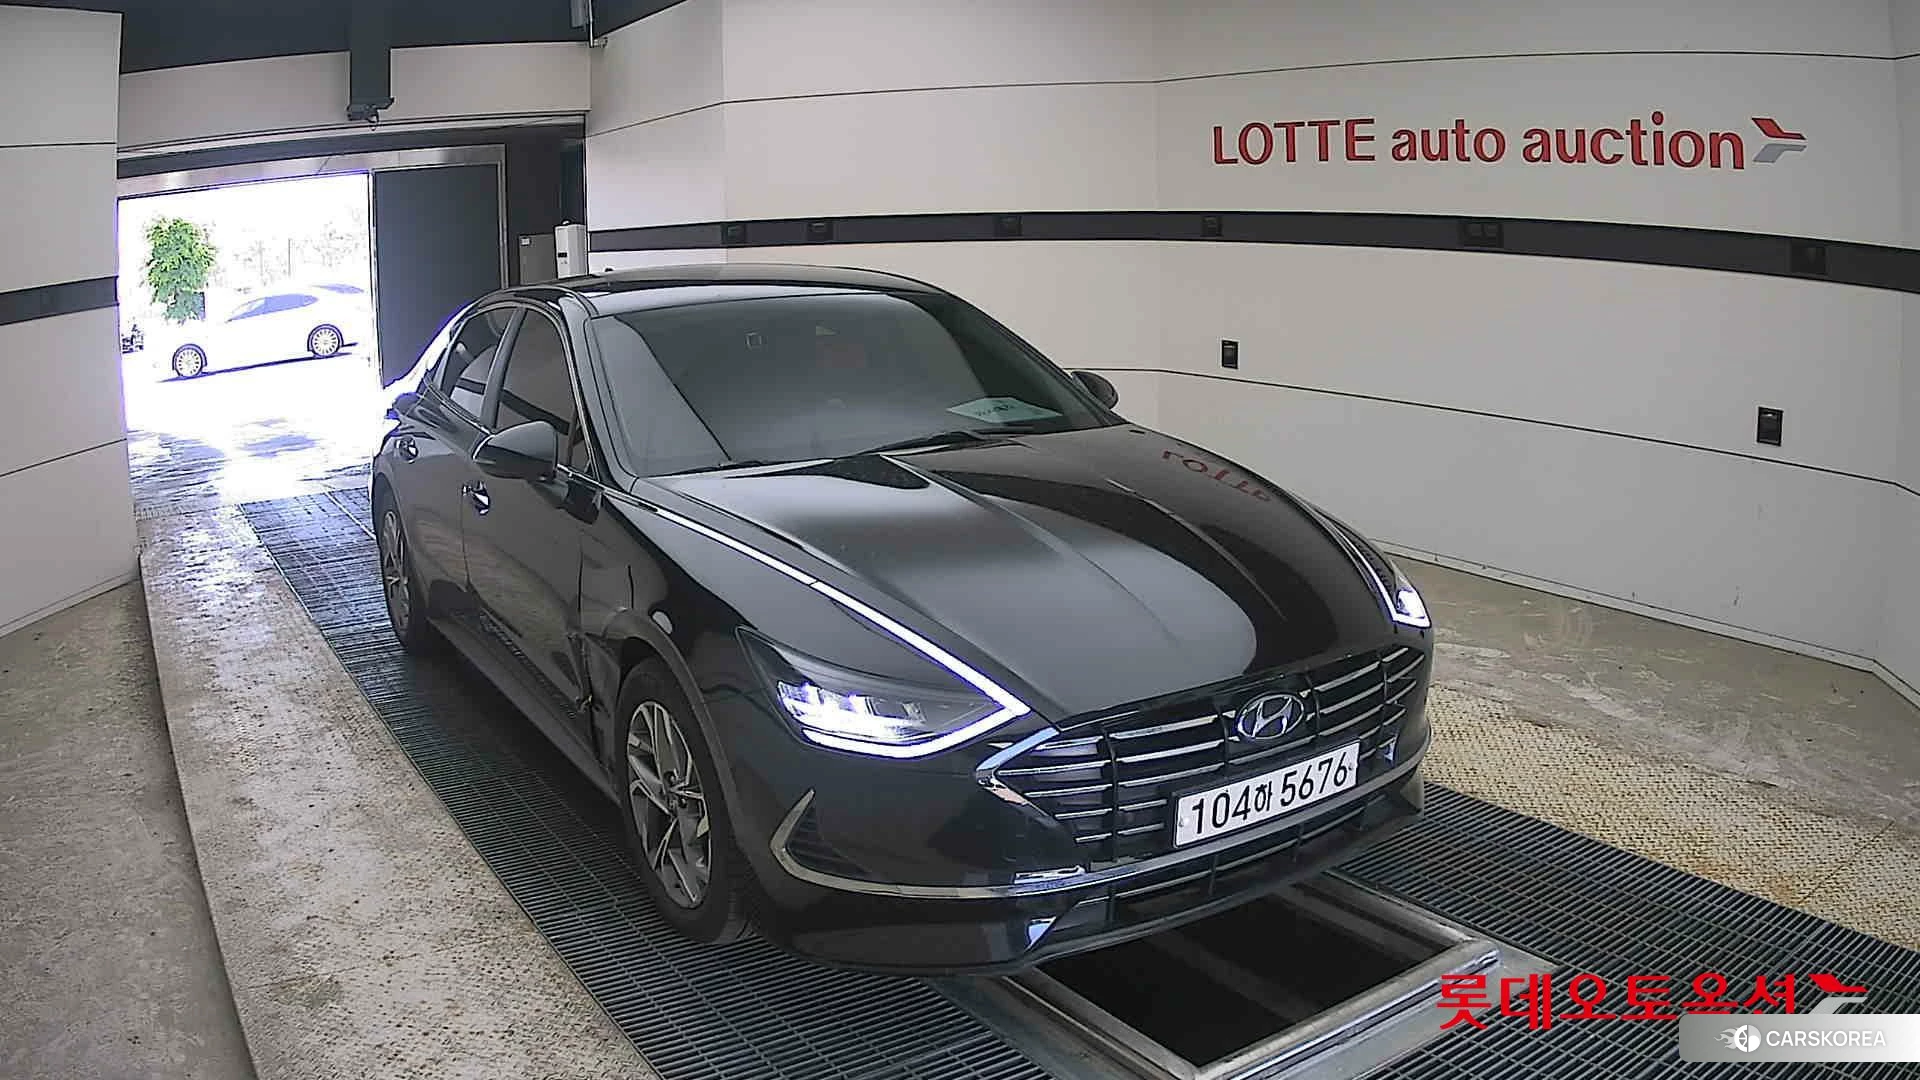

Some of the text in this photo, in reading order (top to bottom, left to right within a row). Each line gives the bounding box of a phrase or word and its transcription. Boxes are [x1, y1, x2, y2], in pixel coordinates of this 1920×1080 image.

[1213, 111, 1744, 169] LOTTE auto auction
[1191, 751, 1348, 834] 104하 5676
